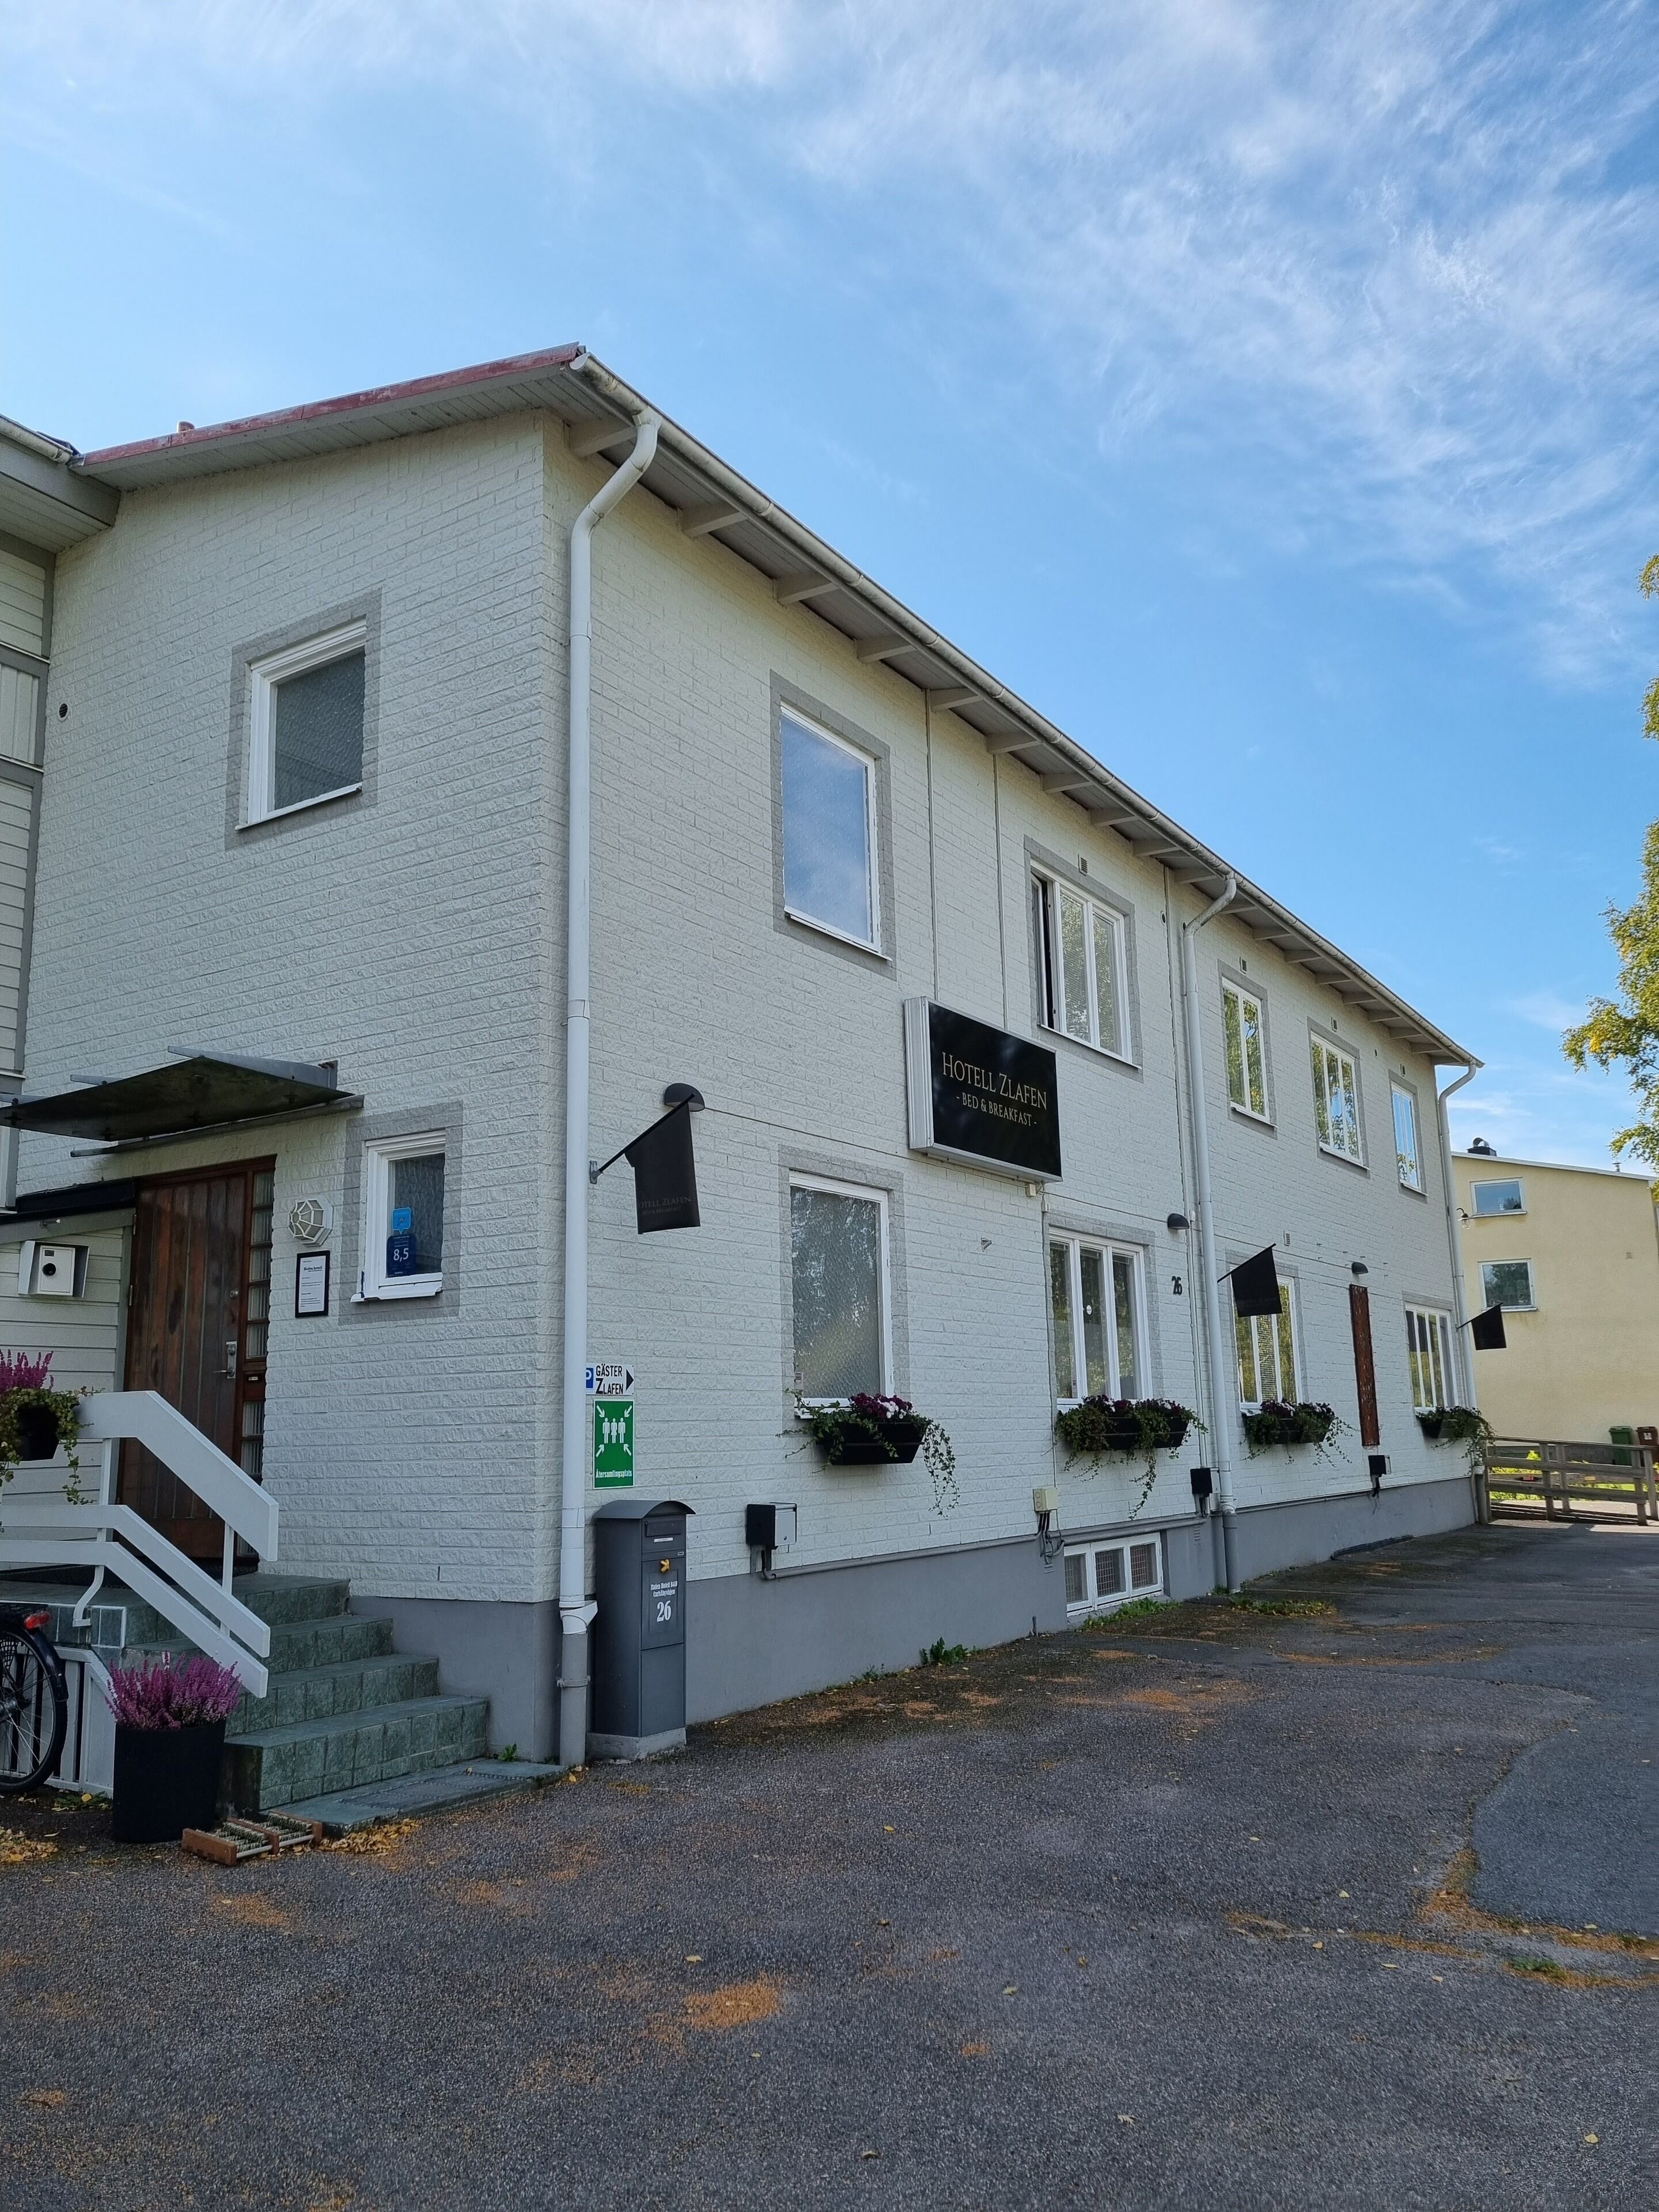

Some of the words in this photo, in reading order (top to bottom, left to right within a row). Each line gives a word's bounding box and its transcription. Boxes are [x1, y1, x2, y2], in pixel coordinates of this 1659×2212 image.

[942, 1052, 997, 1093] HOTELL
[999, 1073, 1047, 1110] ZLAFEN
[962, 1092, 979, 1109] BED
[980, 1099, 987, 1112] &
[988, 1101, 1032, 1127] BREAKFAST
[393, 1248, 409, 1262] 8,5
[1172, 1275, 1183, 1296] 26
[596, 1363, 623, 1377] GÄSTER
[596, 1377, 624, 1394] ZLAFEN
[657, 1600, 672, 1622] 26
